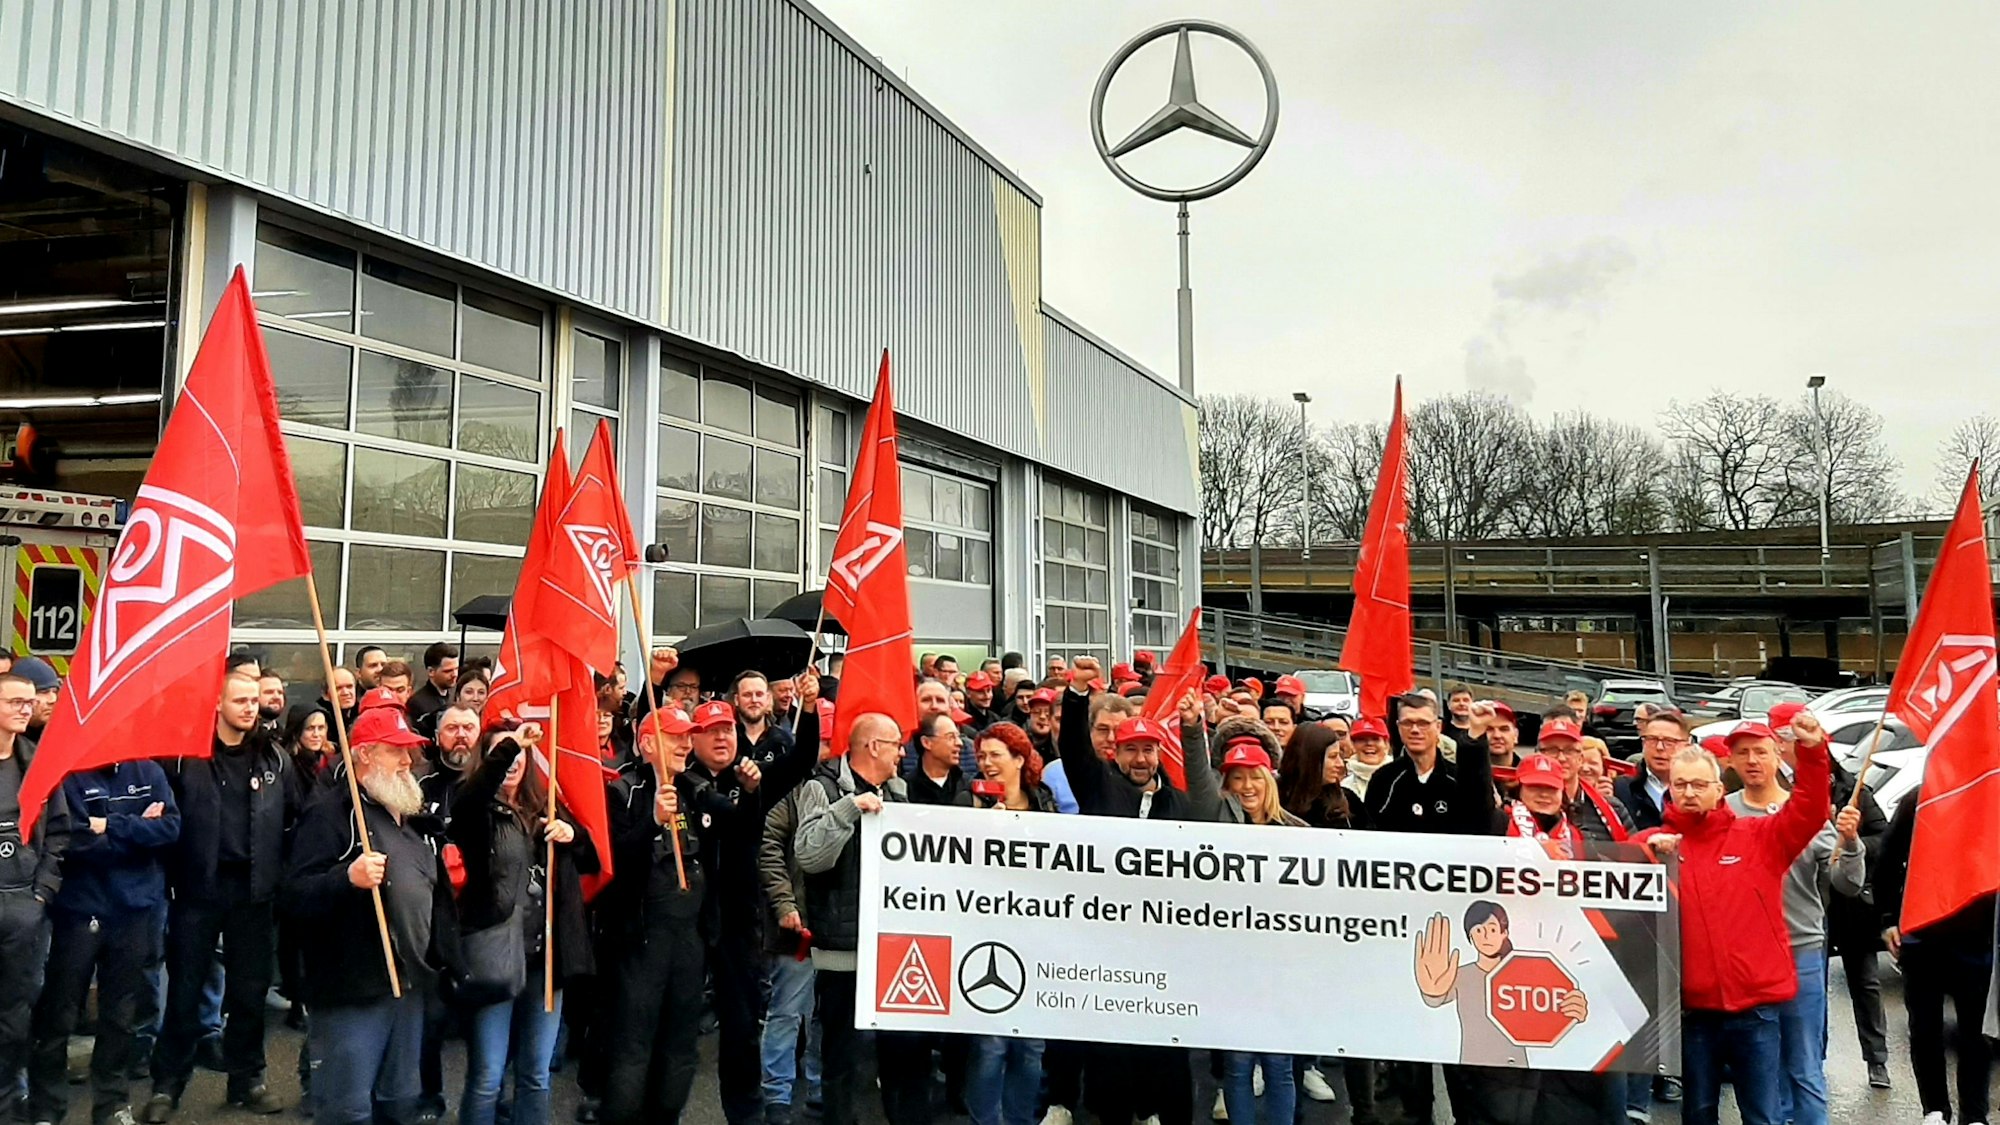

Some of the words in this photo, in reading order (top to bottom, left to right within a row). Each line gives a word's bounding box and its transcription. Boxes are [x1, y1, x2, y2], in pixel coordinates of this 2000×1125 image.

[33, 605, 76, 640] 112
[880, 831, 972, 865] OWN
[984, 838, 1105, 874] RETAIL
[1115, 843, 1268, 883] GEHÖRT
[1278, 856, 1326, 887] ZU
[1337, 859, 1664, 903] MERCEDES-BENZ!
[883, 885, 946, 912] Kein
[955, 889, 1075, 919] Verkauf
[1082, 895, 1132, 922] der
[1142, 899, 1408, 943] Niederlassungen!
[1036, 962, 1167, 989] Niederlassung
[1036, 990, 1075, 1010] Köln
[1081, 994, 1089, 1011] /
[1094, 994, 1200, 1017] Leverkusen
[1497, 984, 1568, 1013] STOP
